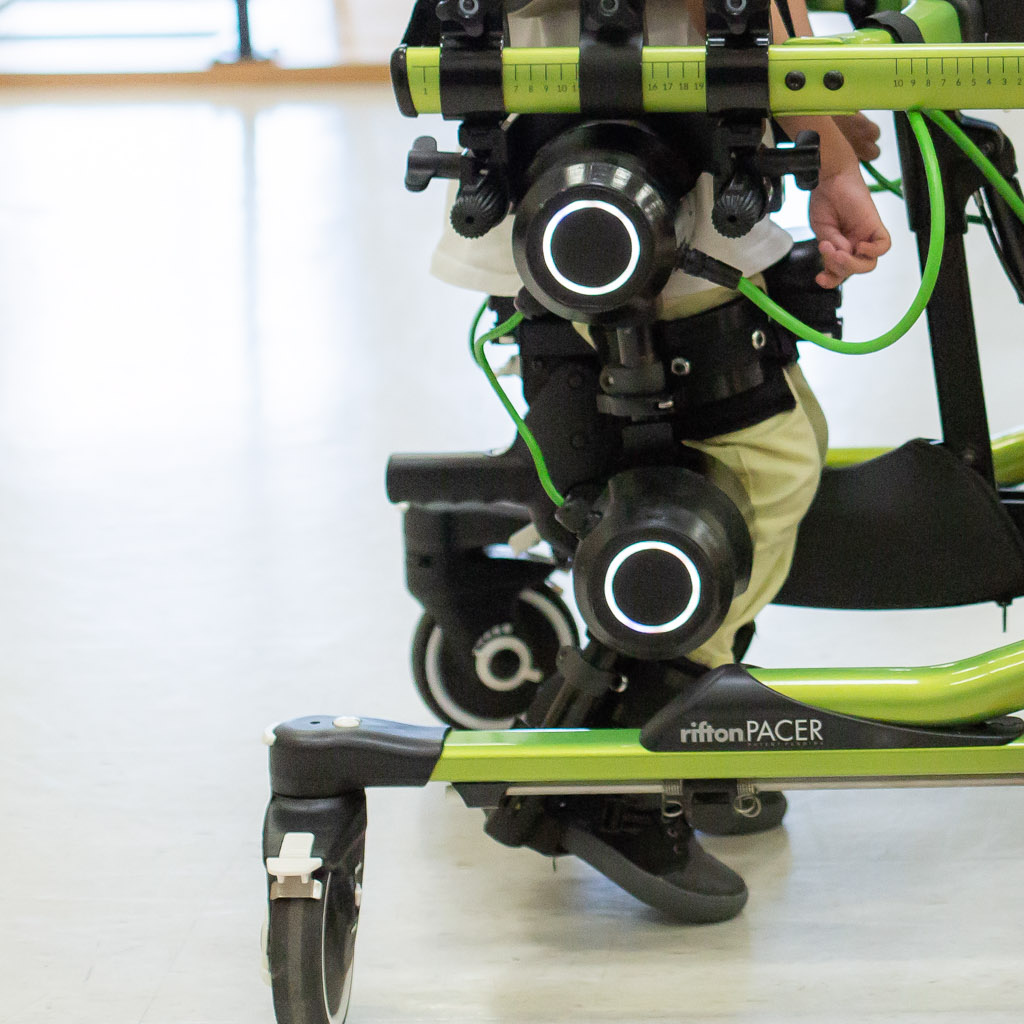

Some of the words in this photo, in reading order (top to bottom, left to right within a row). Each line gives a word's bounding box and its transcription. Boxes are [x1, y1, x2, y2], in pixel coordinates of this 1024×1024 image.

[557, 84, 567, 93] 10
[663, 82, 673, 91] 17
[679, 82, 689, 91] 18
[893, 79, 903, 88] 10
[680, 720, 744, 743] rifton
[746, 718, 823, 742] PACER
